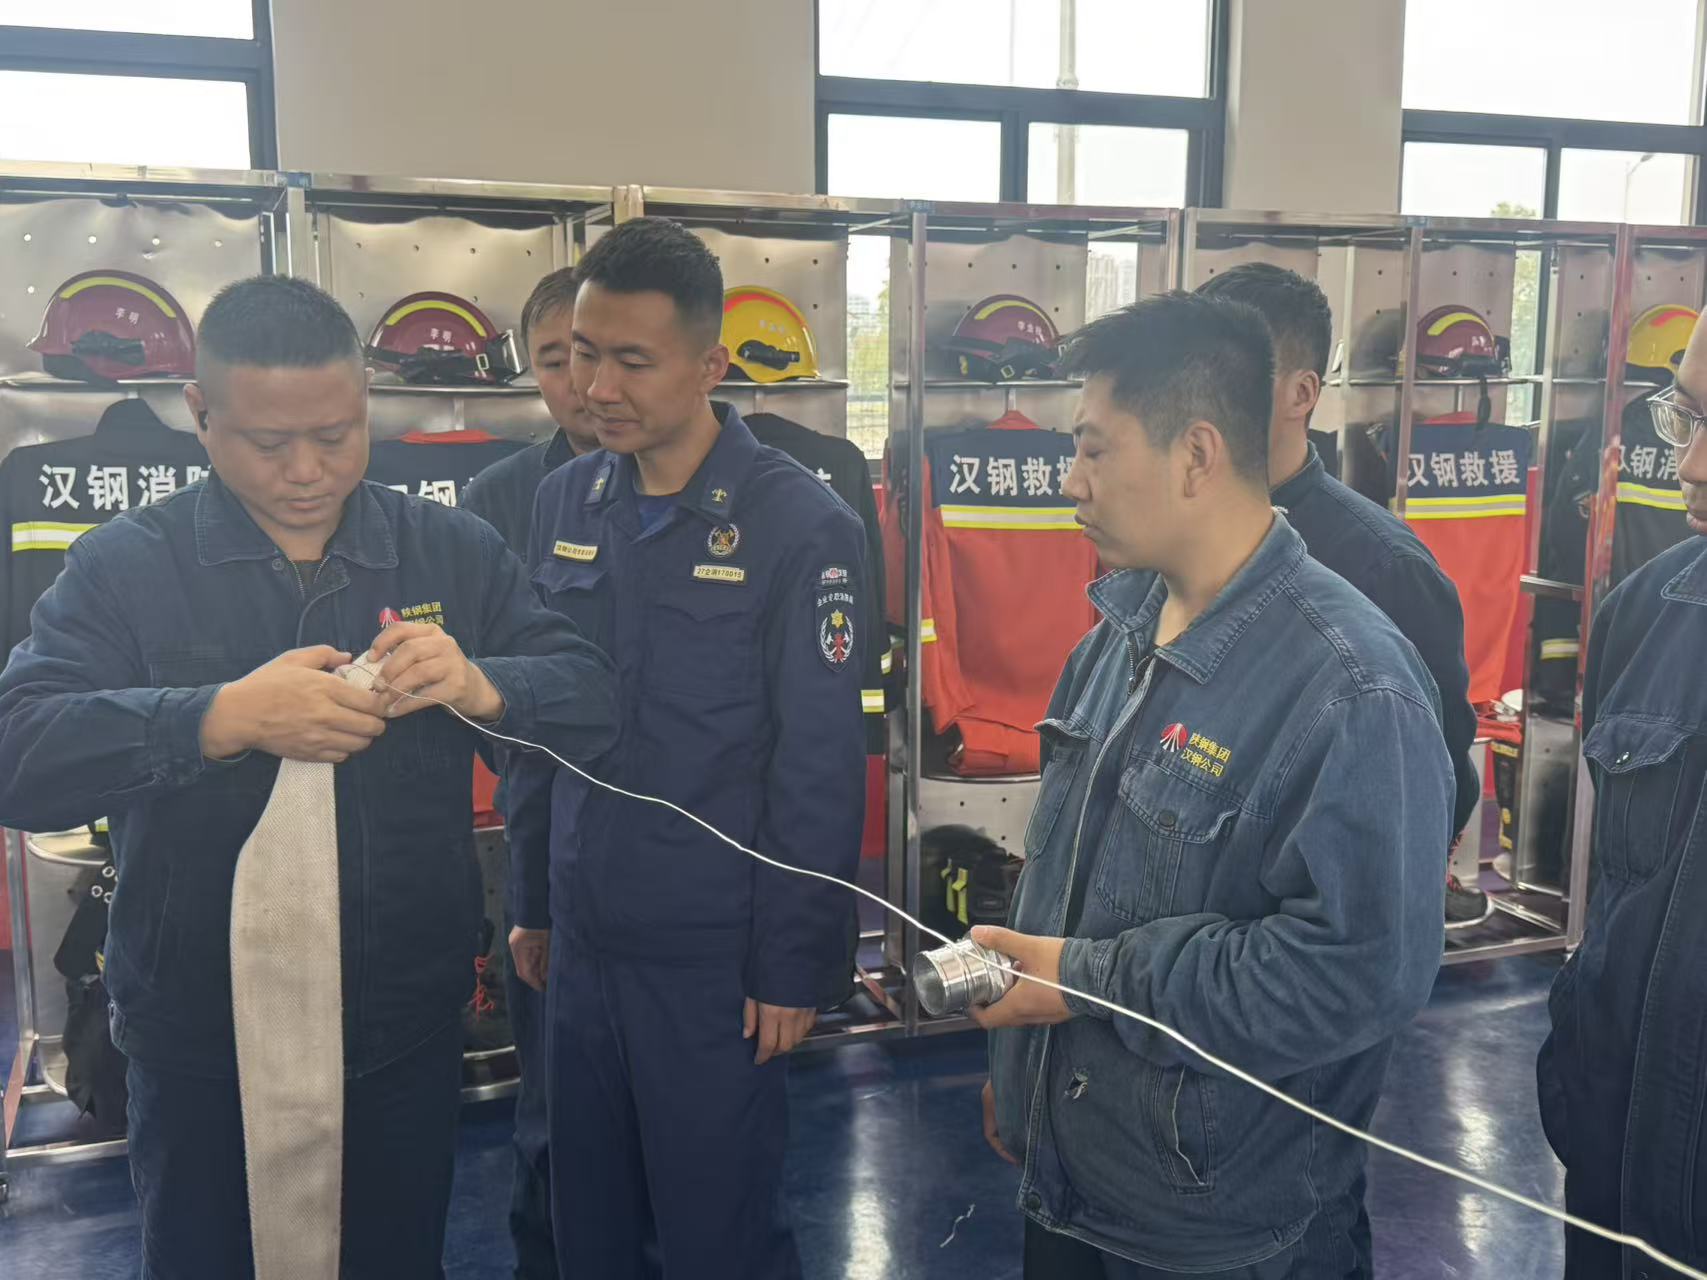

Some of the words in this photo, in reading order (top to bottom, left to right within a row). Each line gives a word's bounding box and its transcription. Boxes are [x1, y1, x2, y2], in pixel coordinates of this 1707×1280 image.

[1181, 748, 1225, 777] 汉钢公司
[1188, 732, 1232, 763] 陕钢集团
